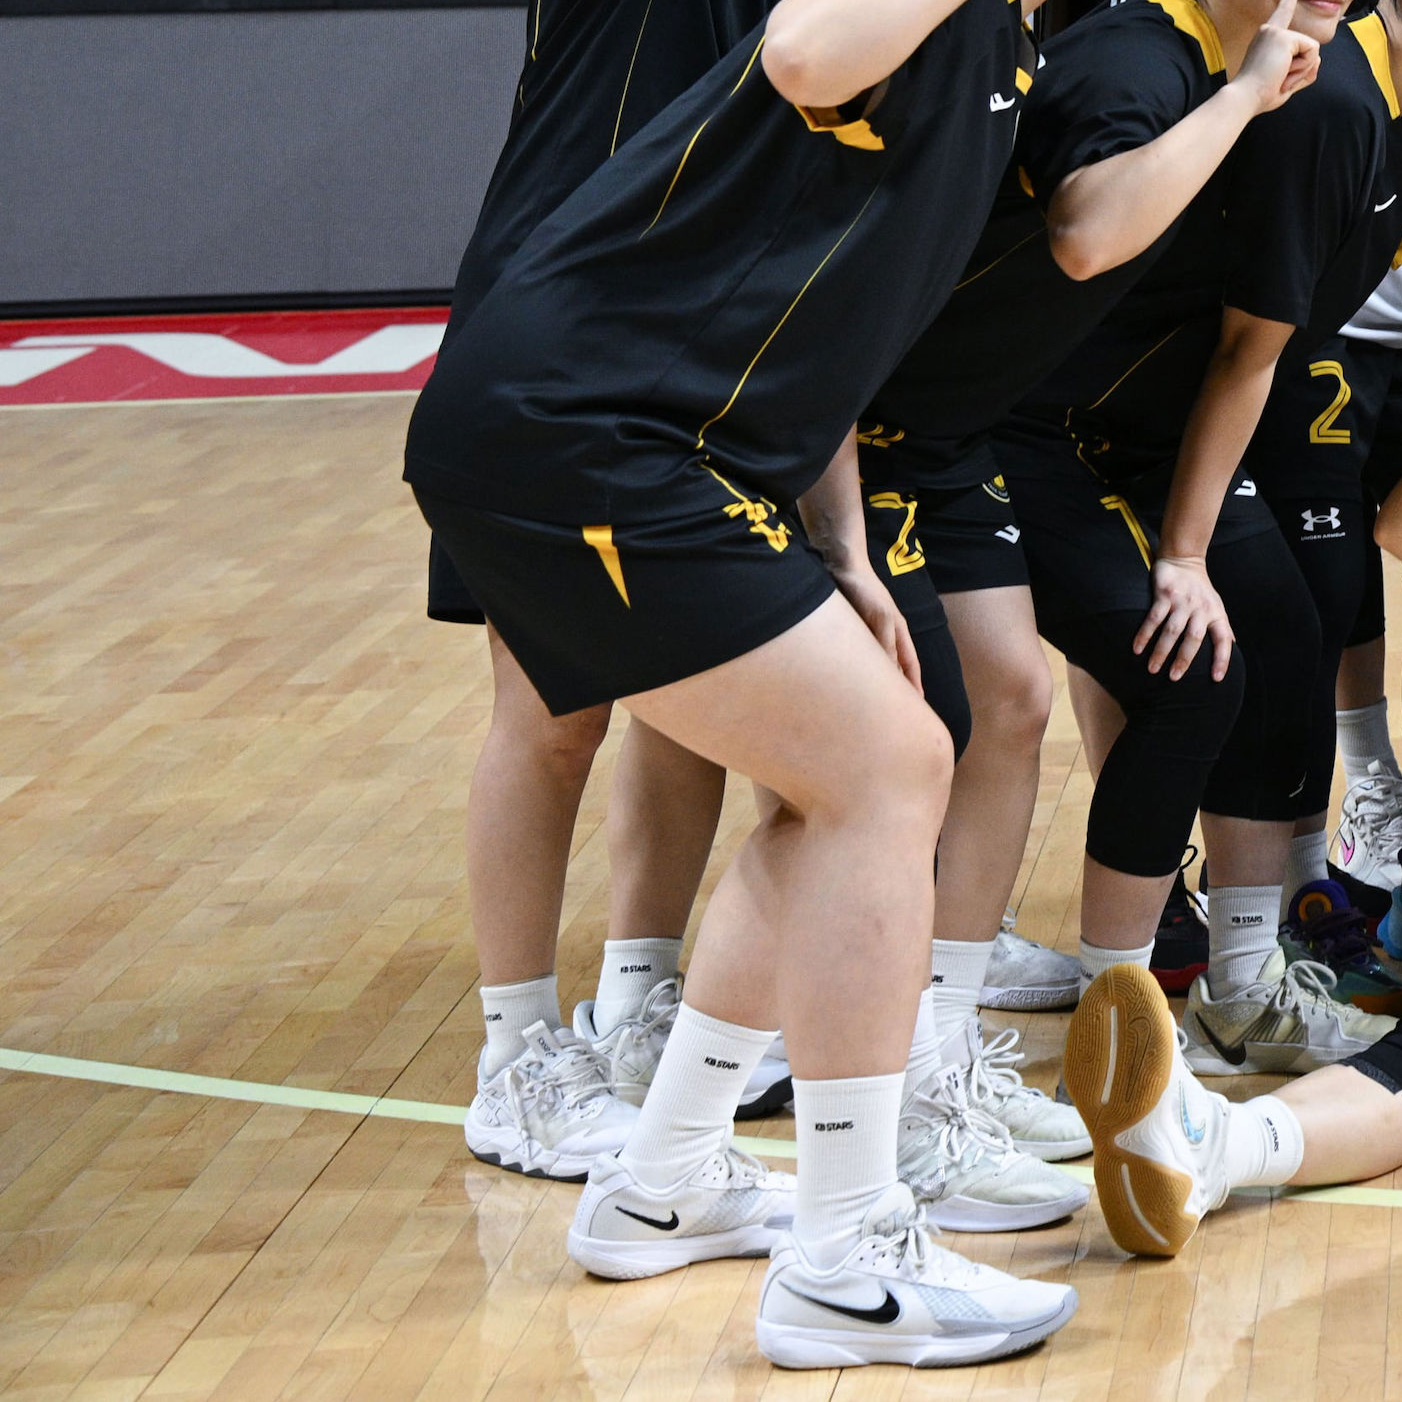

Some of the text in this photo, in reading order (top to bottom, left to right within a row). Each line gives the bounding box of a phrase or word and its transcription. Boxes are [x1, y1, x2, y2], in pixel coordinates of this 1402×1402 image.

[1309, 359, 1352, 445] 2
[717, 1060, 741, 1071] STARS
[827, 1120, 854, 1131] STARS
